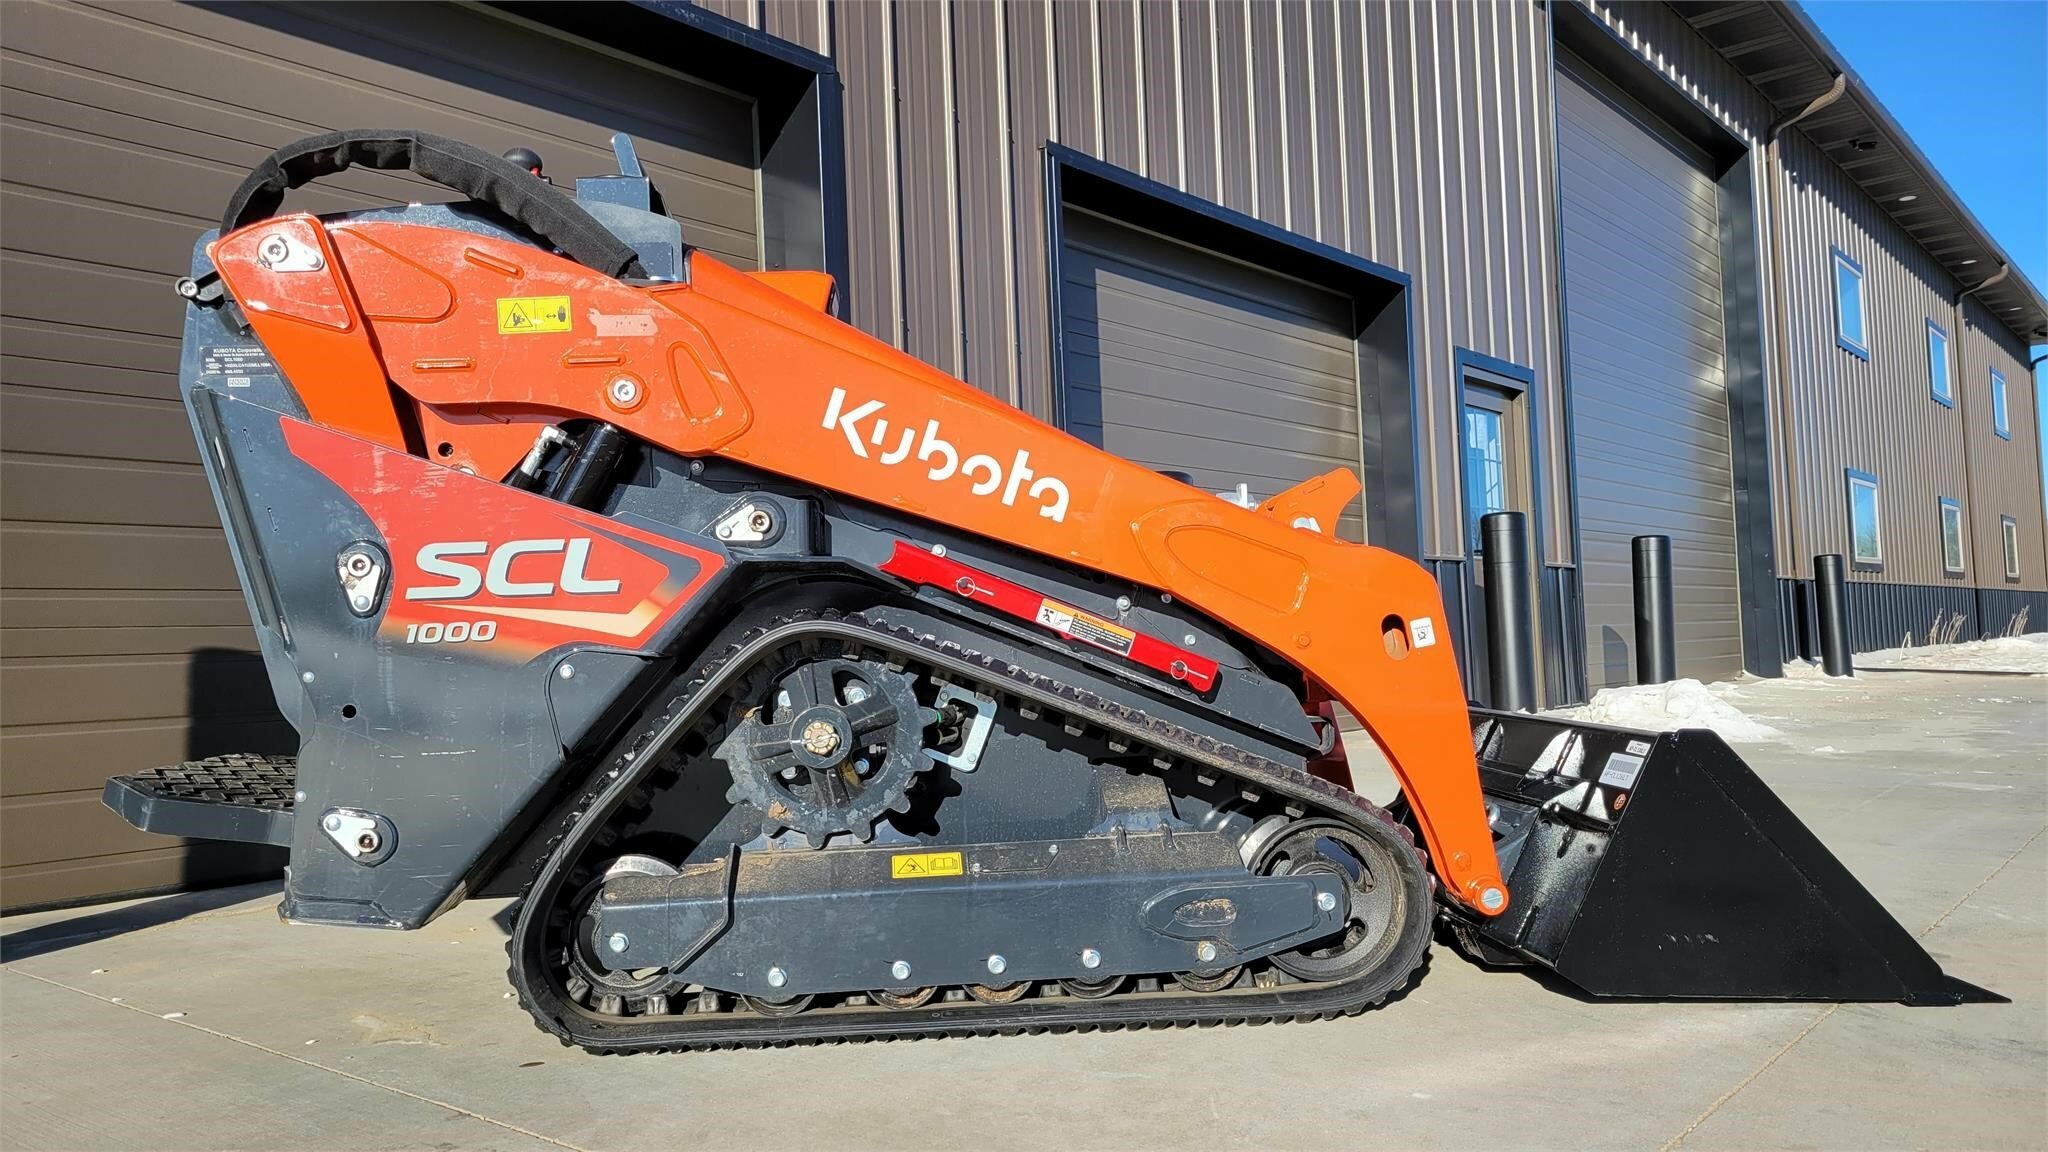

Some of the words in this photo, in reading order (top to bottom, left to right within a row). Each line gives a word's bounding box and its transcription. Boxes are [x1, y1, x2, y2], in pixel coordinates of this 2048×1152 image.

[821, 386, 1070, 523] Kubota
[405, 538, 621, 601] SCL
[406, 620, 497, 644] 1000
[1080, 615, 1105, 627] WARNING
